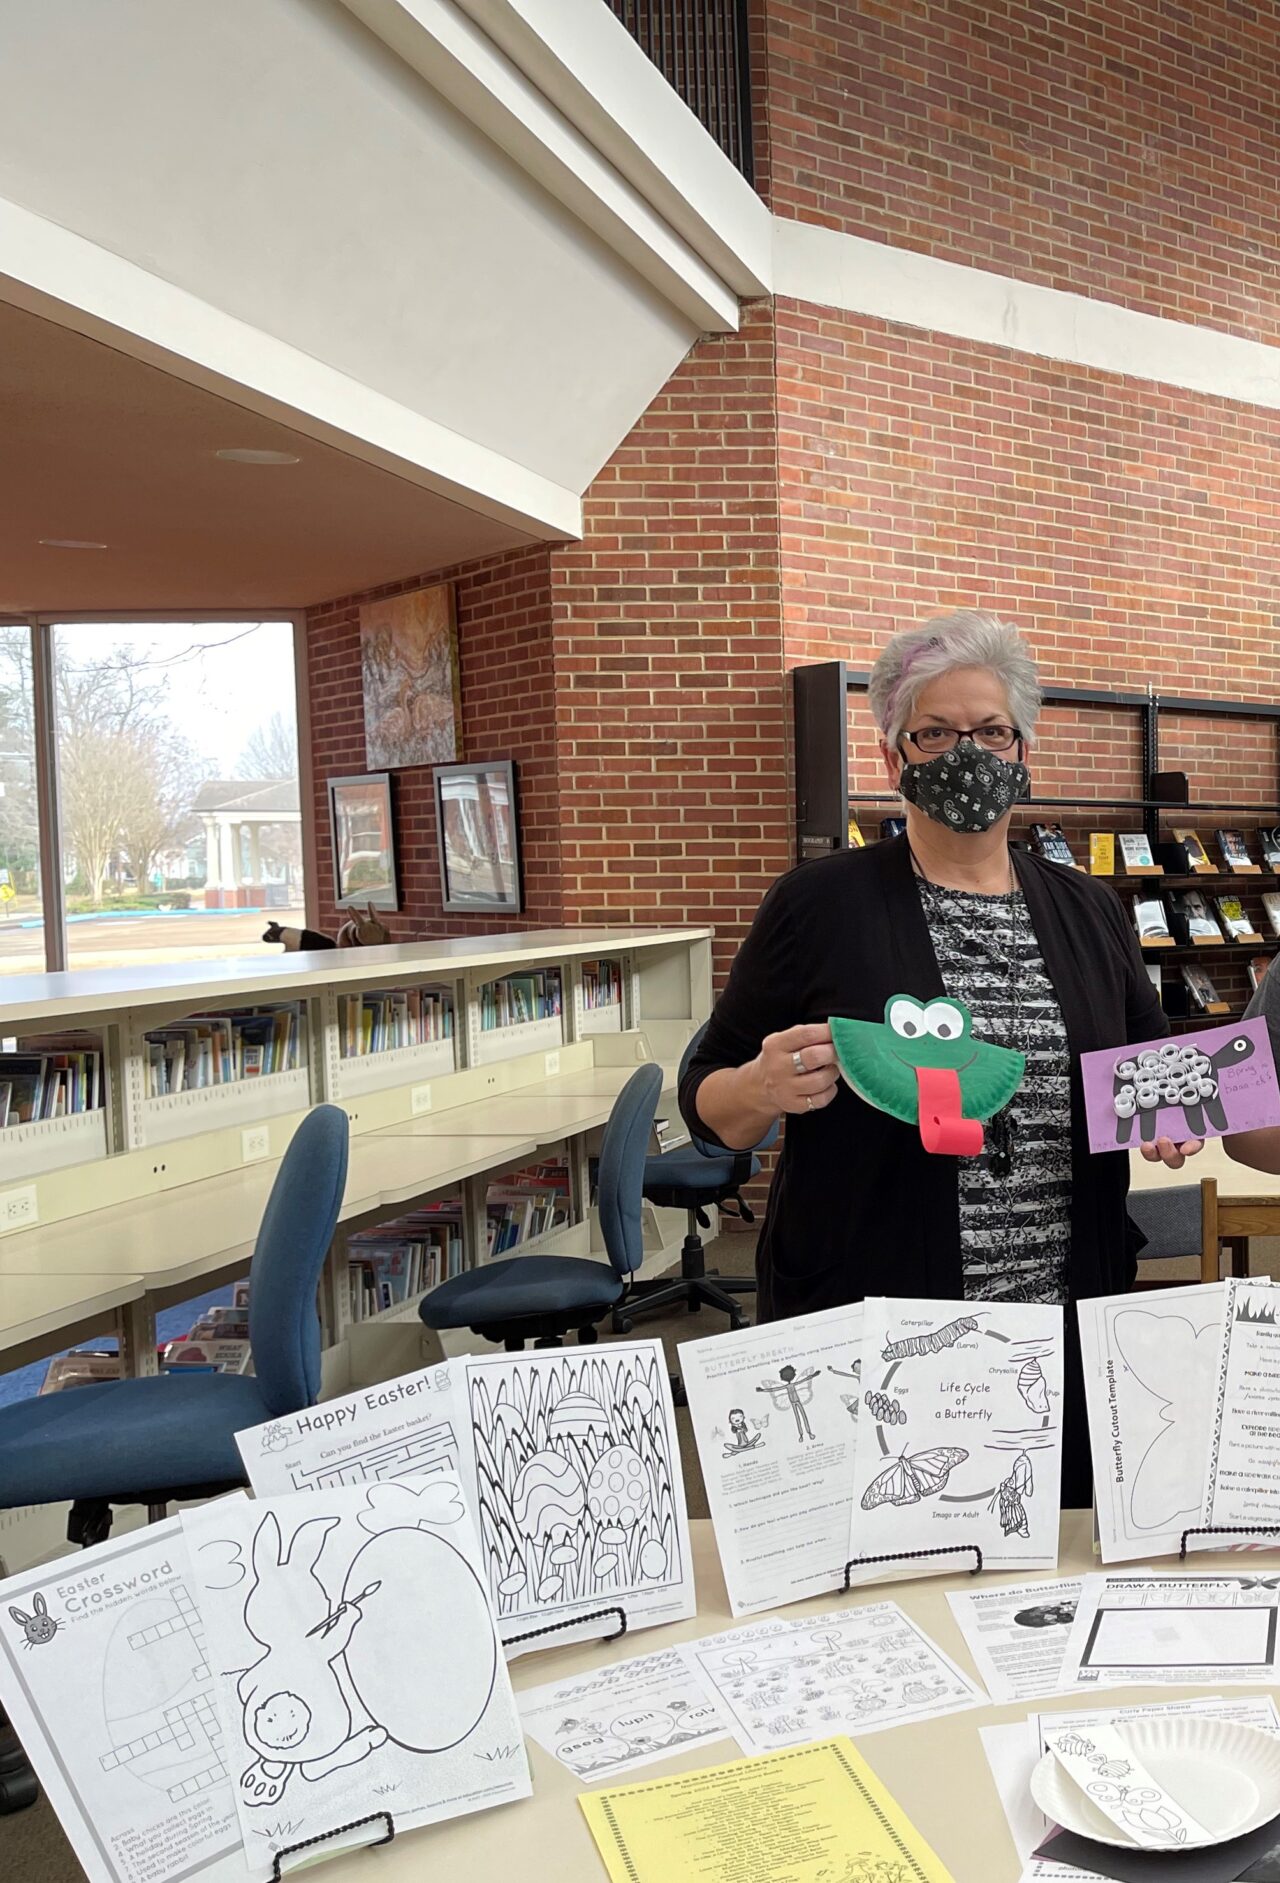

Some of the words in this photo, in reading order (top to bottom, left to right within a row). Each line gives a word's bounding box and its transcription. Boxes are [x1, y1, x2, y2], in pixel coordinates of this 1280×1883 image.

[901, 1319, 934, 1327] Caterpillar
[893, 1387, 909, 1395] Eggs
[940, 1382, 961, 1393] Life
[963, 1382, 990, 1393] Cycle
[1106, 1360, 1117, 1404] Template
[296, 1403, 357, 1435] Happy
[365, 1375, 431, 1410] Easter!
[935, 1411, 942, 1419] a
[944, 1409, 993, 1421] Butterfly
[955, 1395, 967, 1406] of
[320, 1448, 337, 1459] Can
[338, 1442, 352, 1455] you
[353, 1436, 368, 1448] find
[369, 1432, 382, 1441] the
[383, 1425, 405, 1436] Easter
[406, 1413, 432, 1428] basket?
[1110, 1404, 1120, 1438] Cutout
[1112, 1440, 1124, 1483] Butterfly
[932, 1511, 951, 1519] Imago
[57, 1572, 105, 1599] Easter
[65, 1561, 173, 1613] Crossword
[71, 1611, 90, 1623] Find
[90, 1606, 104, 1617] the
[105, 1594, 133, 1612] hidden
[135, 1585, 158, 1598] words
